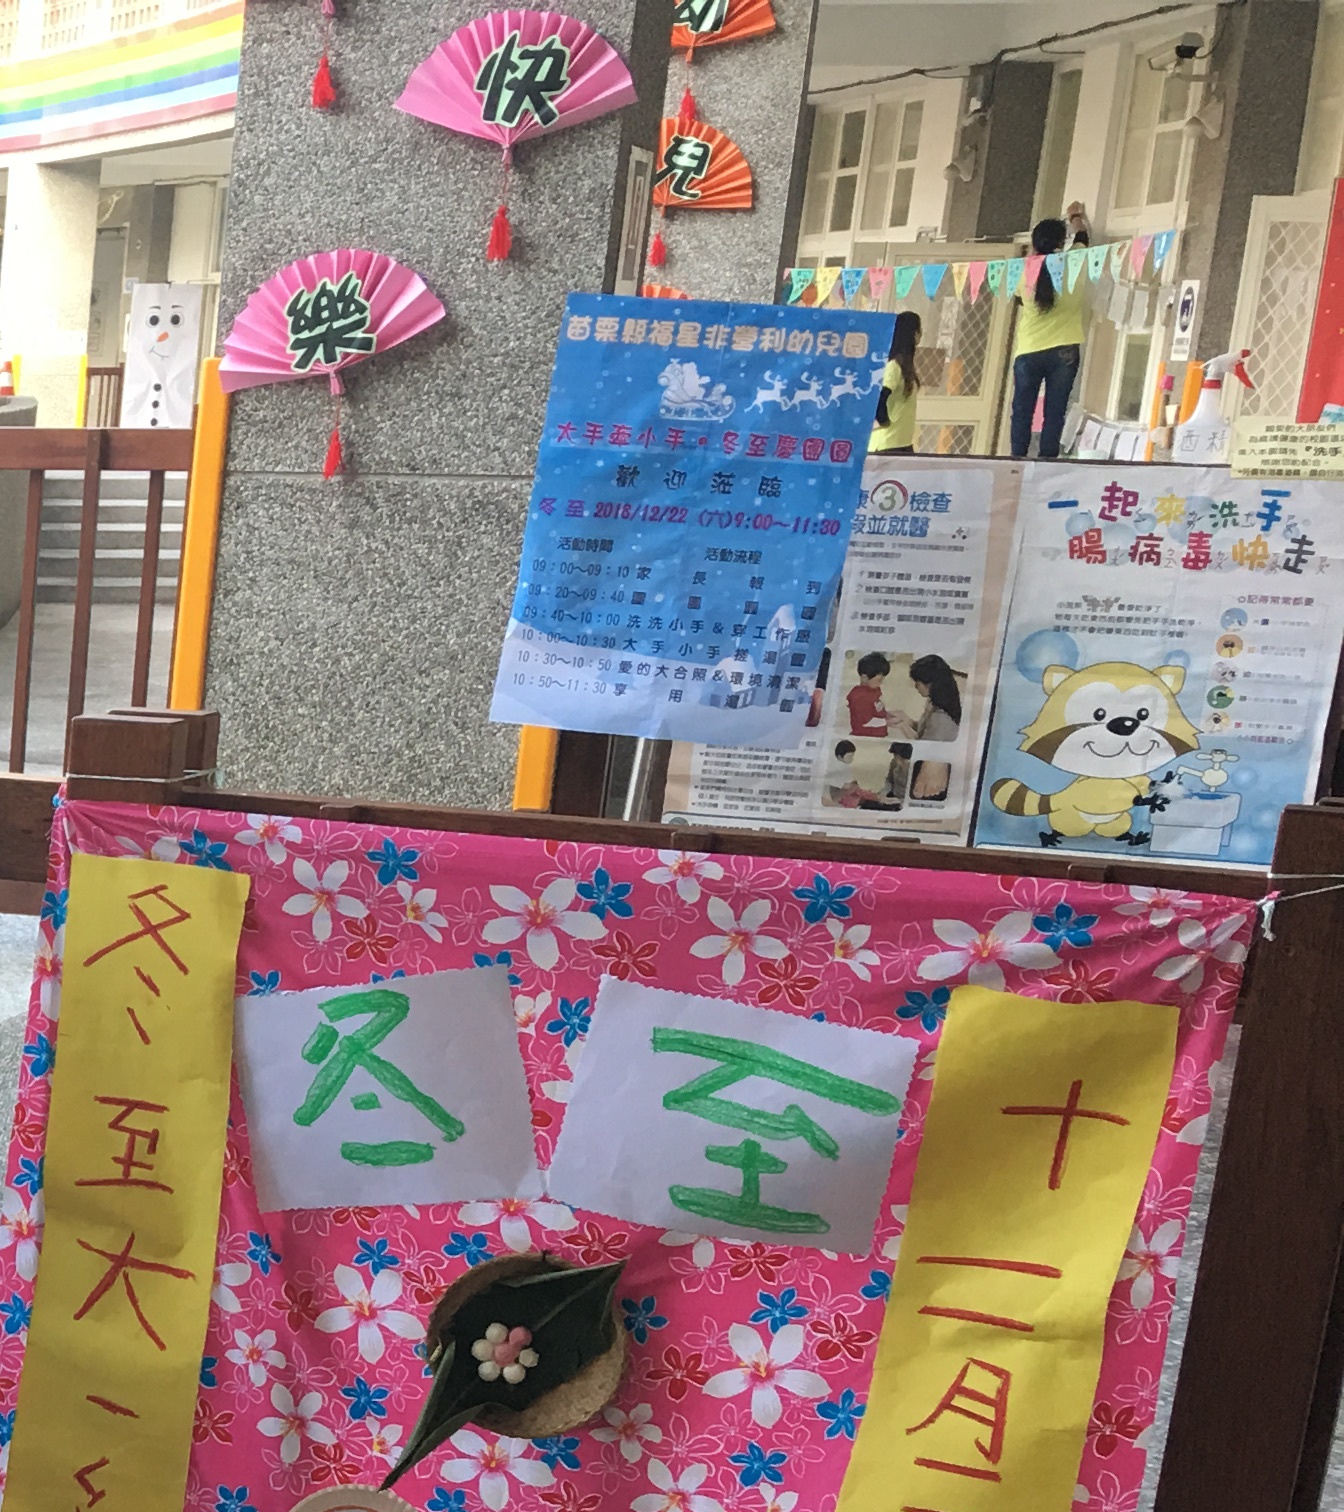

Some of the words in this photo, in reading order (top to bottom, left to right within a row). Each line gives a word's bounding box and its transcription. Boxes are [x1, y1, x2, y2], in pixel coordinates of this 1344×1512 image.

[476, 32, 569, 126] 快
[288, 273, 375, 372] 樂
[566, 315, 869, 358] 苗栗縣福星非營利幼兒園
[539, 498, 585, 518] 冬至
[1048, 481, 1291, 531] 一起來洗手
[556, 536, 614, 554] 活動時間
[704, 547, 762, 565] 活動流程
[1068, 528, 1315, 574] 腸病毒快走
